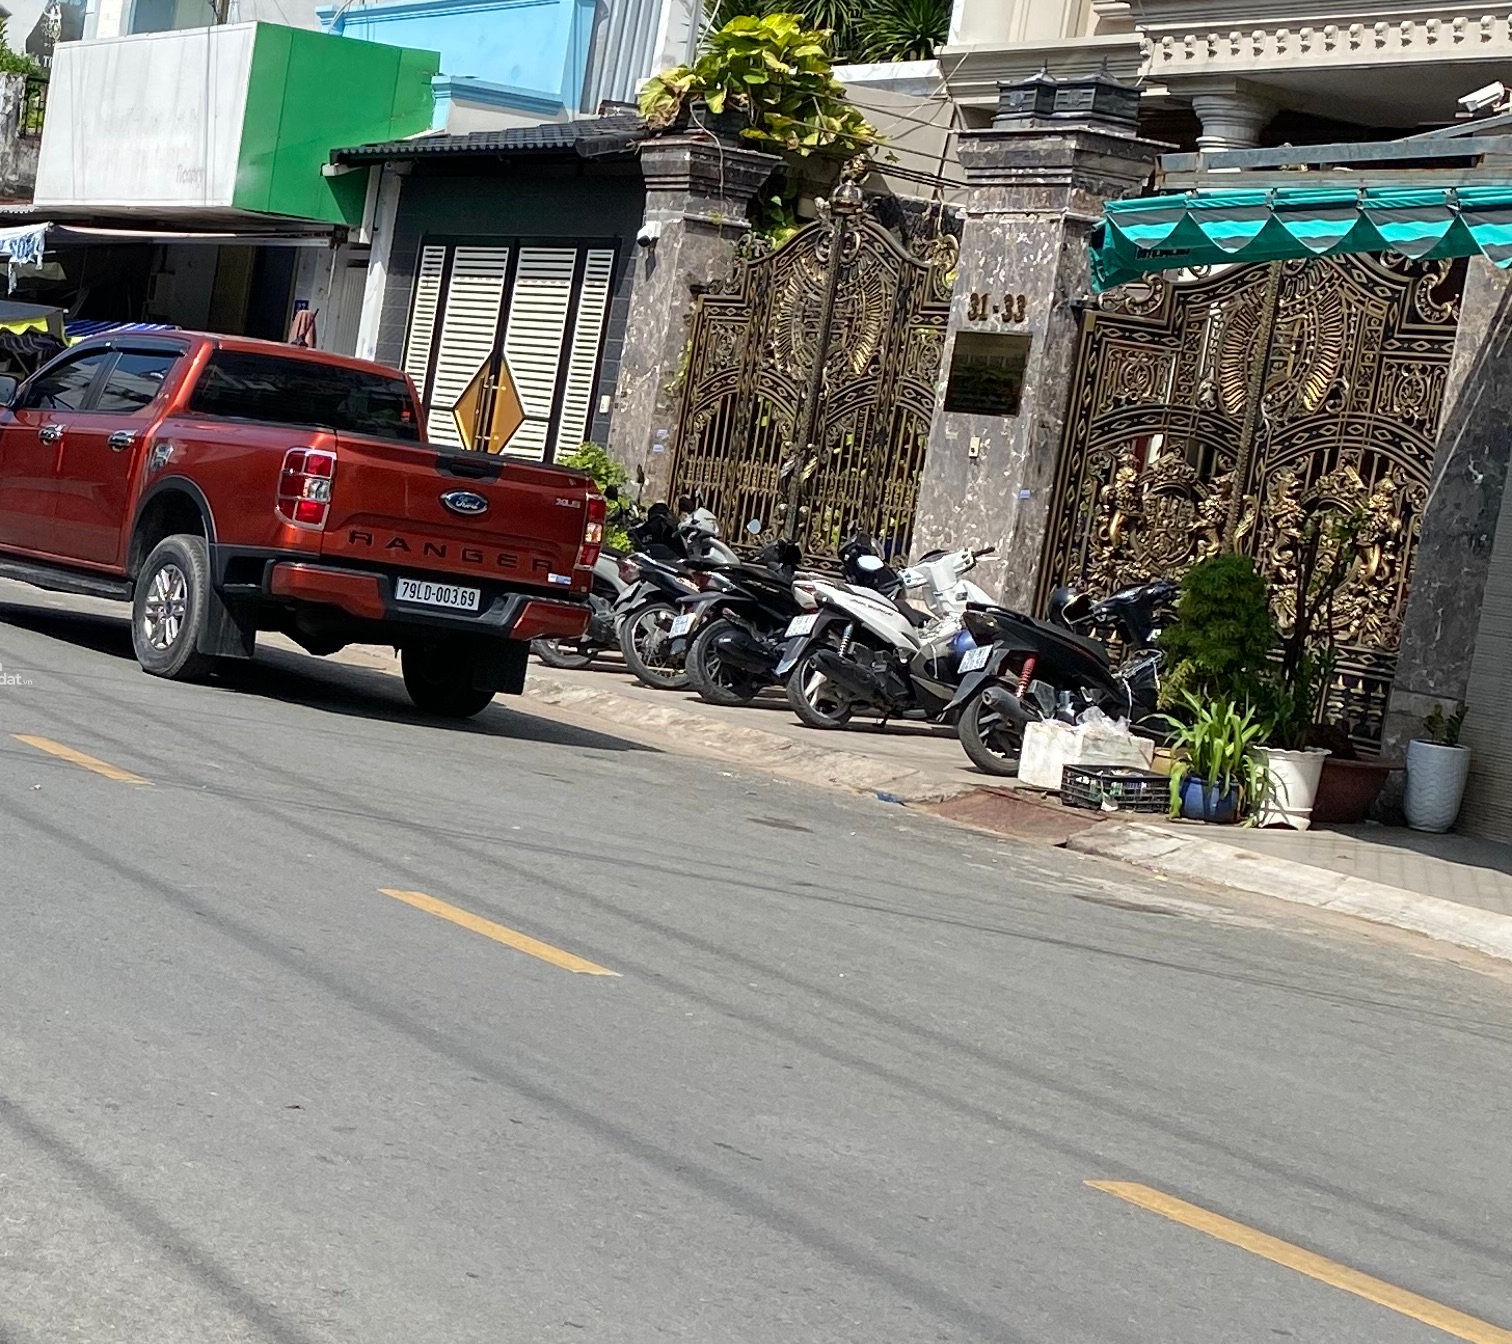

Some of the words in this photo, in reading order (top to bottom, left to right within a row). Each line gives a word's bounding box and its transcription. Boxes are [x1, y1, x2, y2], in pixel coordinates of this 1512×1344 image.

[455, 496, 481, 510] Ford
[348, 529, 553, 574] RANGER
[401, 580, 476, 608] 79LD-003.69
